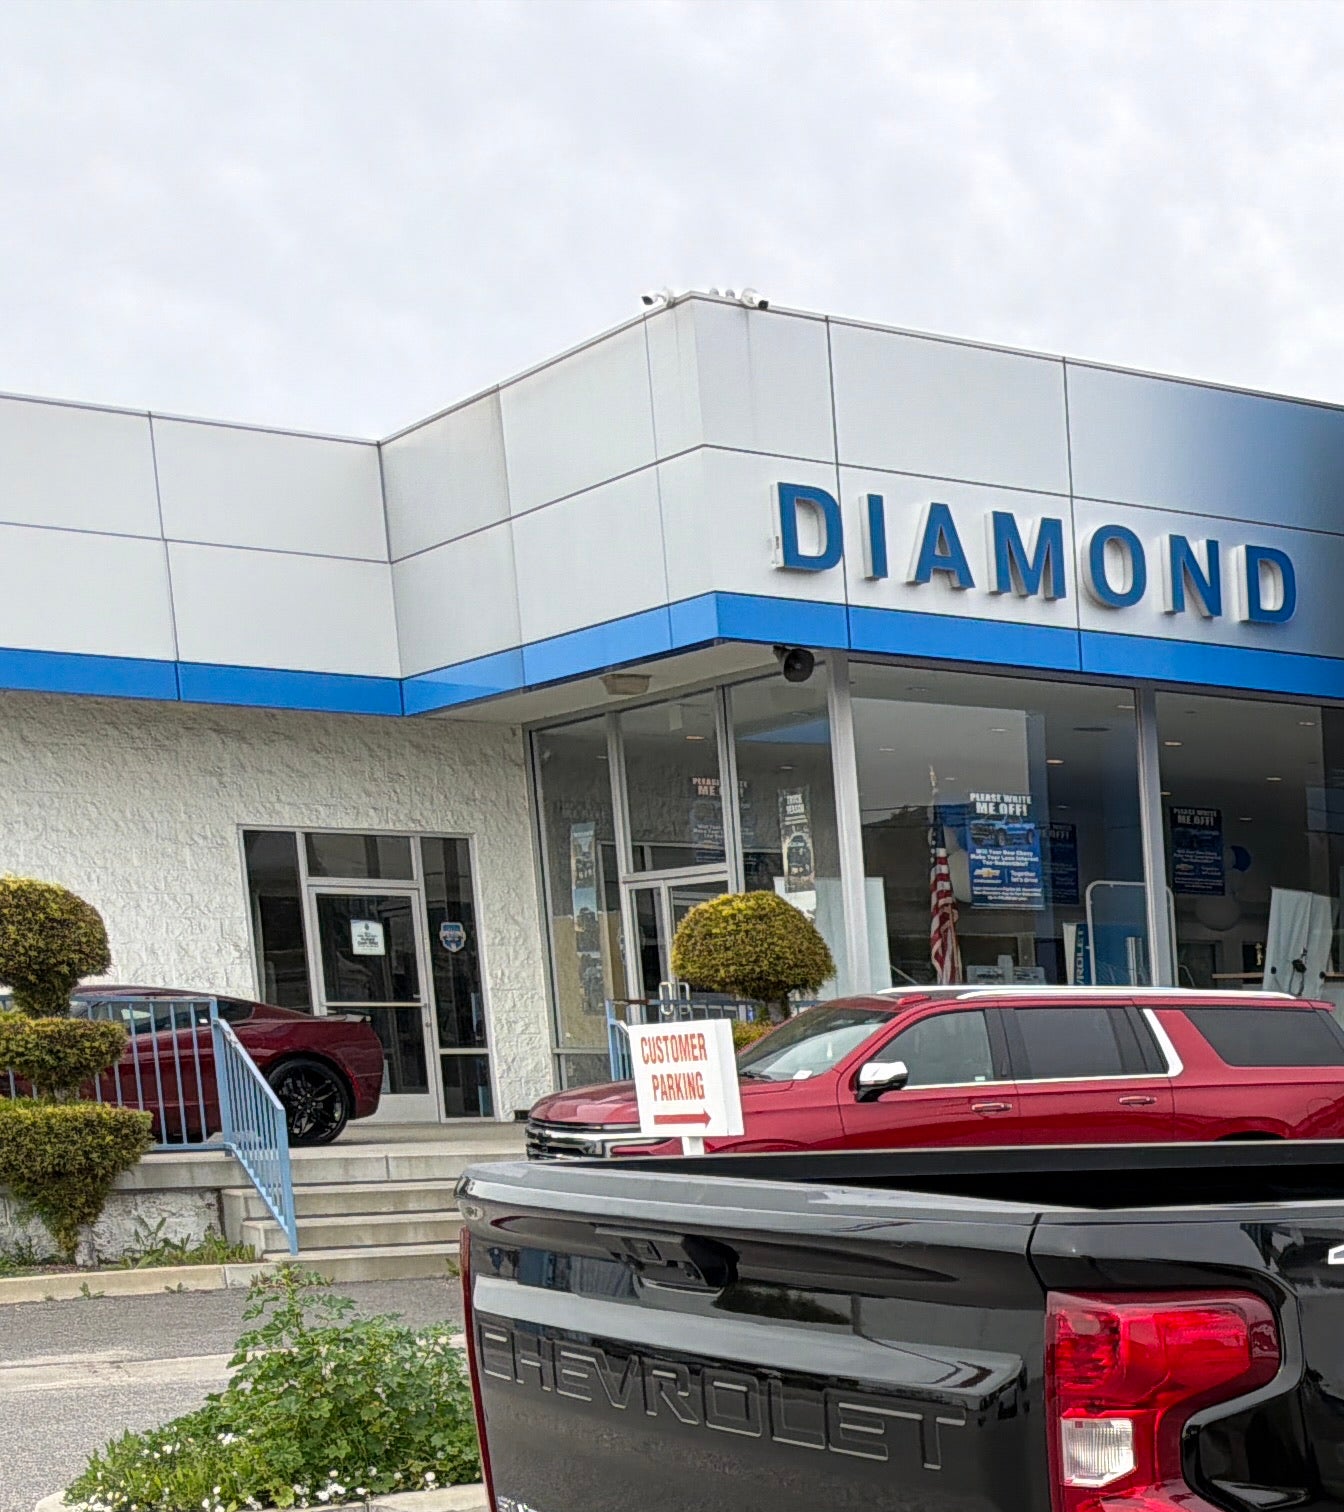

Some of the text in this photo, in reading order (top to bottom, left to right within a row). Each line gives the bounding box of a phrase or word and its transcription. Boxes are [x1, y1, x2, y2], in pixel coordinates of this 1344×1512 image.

[772, 480, 1297, 624] DIAMOND
[697, 785, 715, 796] ME
[970, 793, 1032, 804] PLEASE WRITE
[976, 802, 1027, 816] ME OFF!
[640, 1033, 708, 1064] CUSTOMER
[651, 1071, 705, 1101] PARKING
[478, 1322, 967, 1470] CHEVROLET
